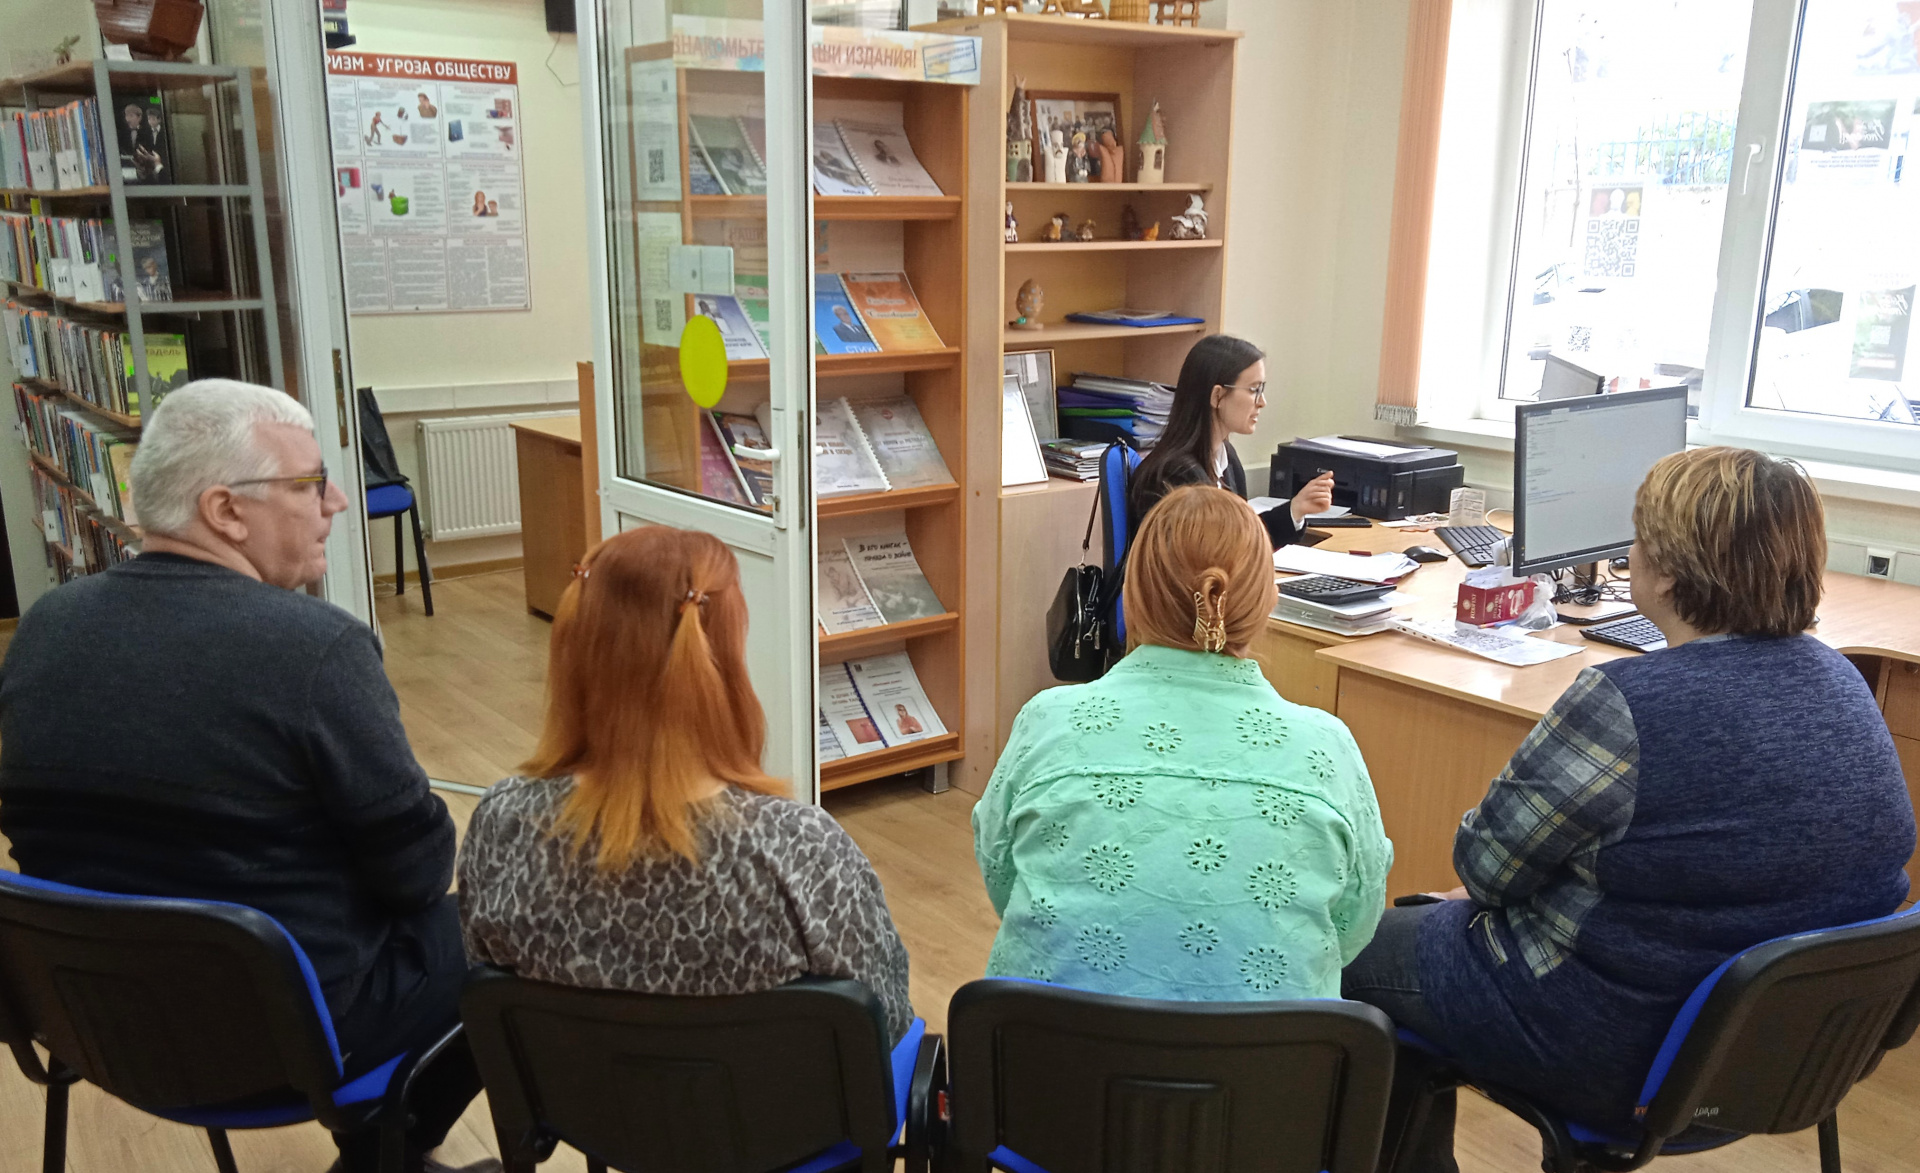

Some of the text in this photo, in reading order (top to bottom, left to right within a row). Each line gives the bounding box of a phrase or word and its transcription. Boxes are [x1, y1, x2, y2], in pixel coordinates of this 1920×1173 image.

[672, 34, 764, 59] ЗНАКОМЬТЕ
[846, 46, 917, 69] ИЗДАНИЯ!
[327, 55, 365, 71] РИЗМ
[376, 57, 432, 76] УГРОЗА
[435, 61, 511, 80] ОБЩЕСТВУ
